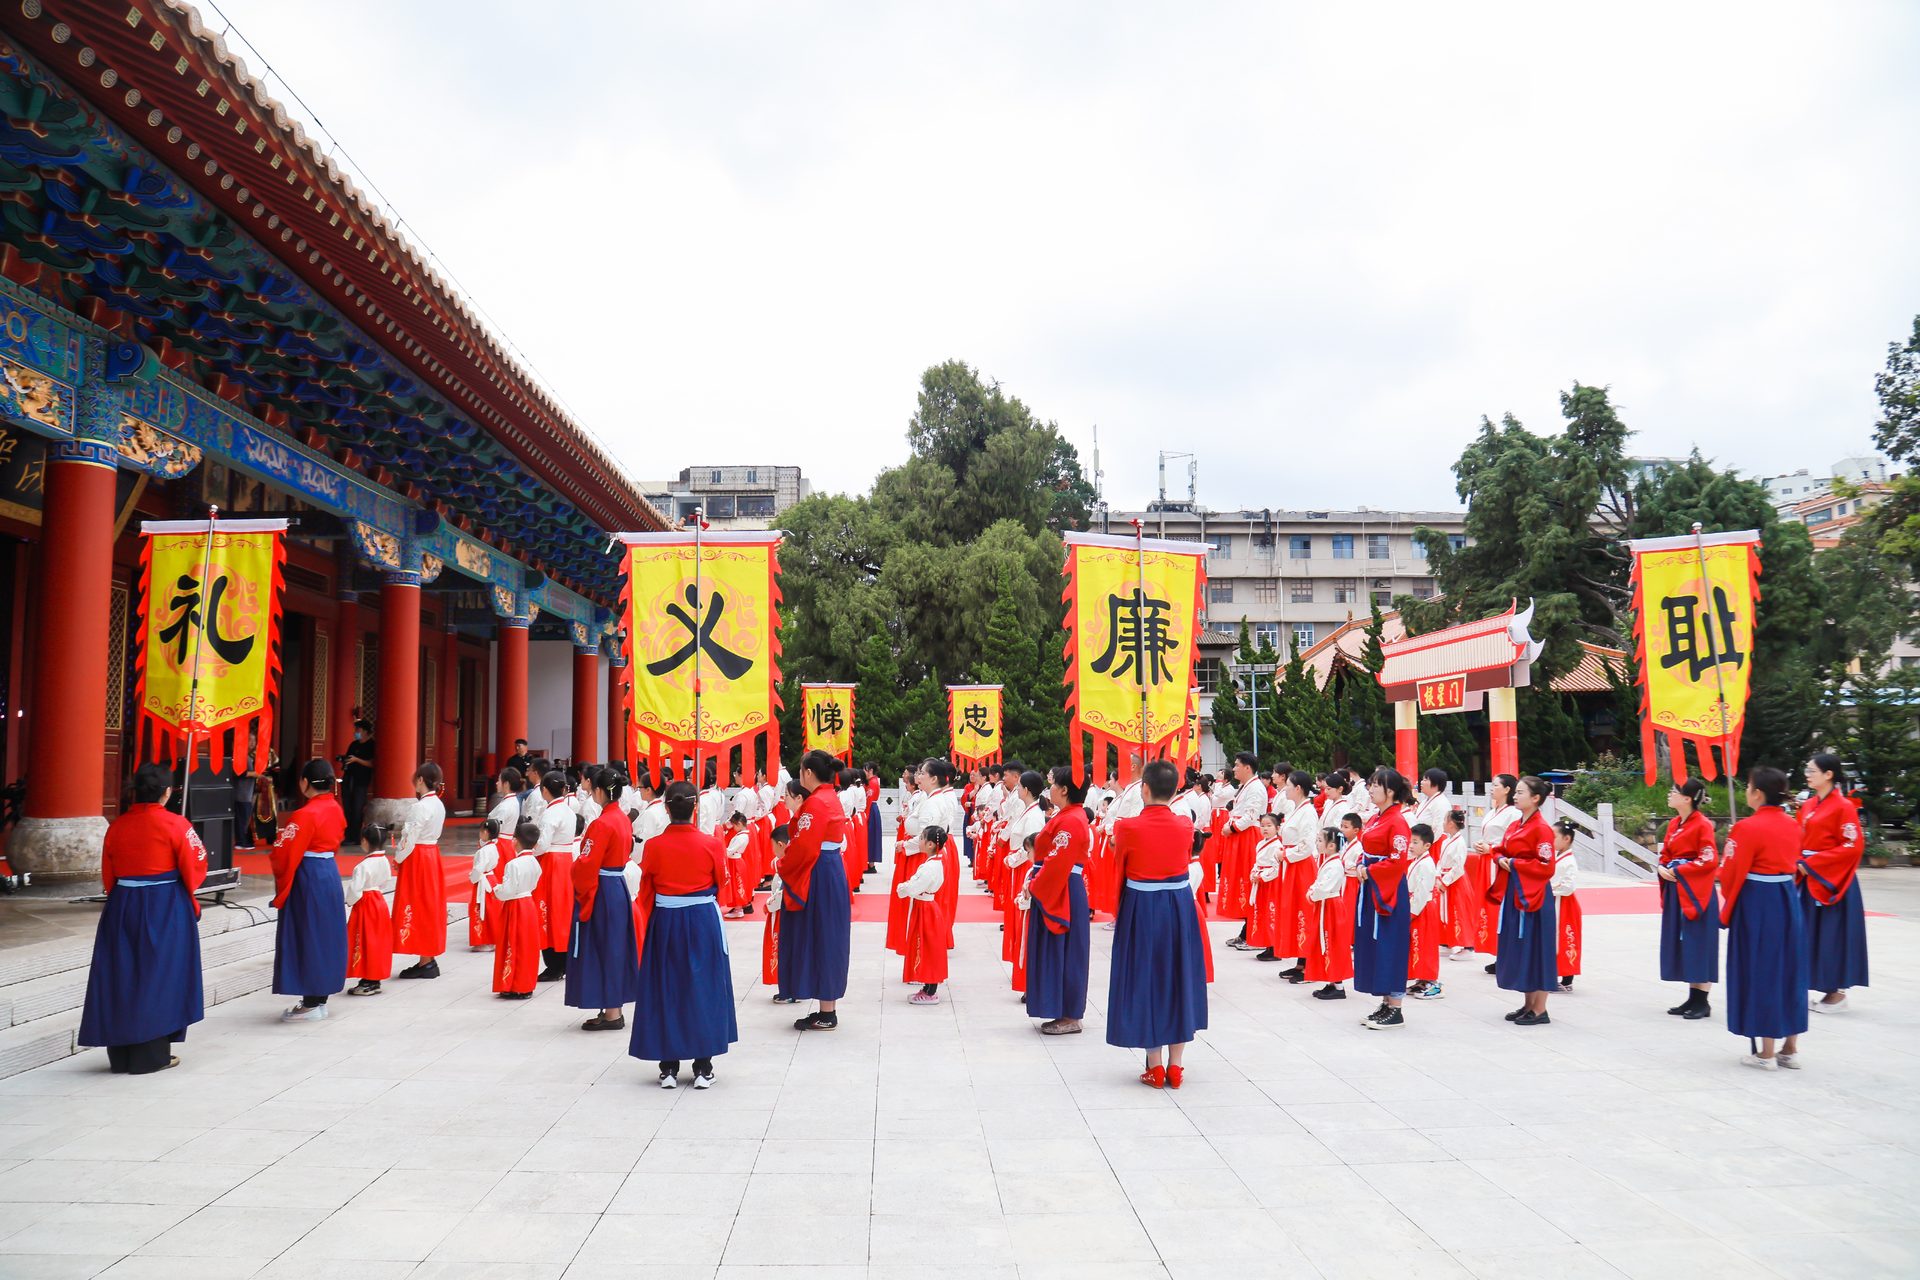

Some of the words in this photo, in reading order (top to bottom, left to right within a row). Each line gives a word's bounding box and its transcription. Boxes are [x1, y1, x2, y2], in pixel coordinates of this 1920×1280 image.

[159, 575, 254, 665] 礼
[646, 583, 753, 680] 义
[1091, 586, 1179, 686] 廉
[1661, 586, 1744, 682] 耻
[812, 702, 844, 736] 悌
[958, 703, 994, 738] 忠
